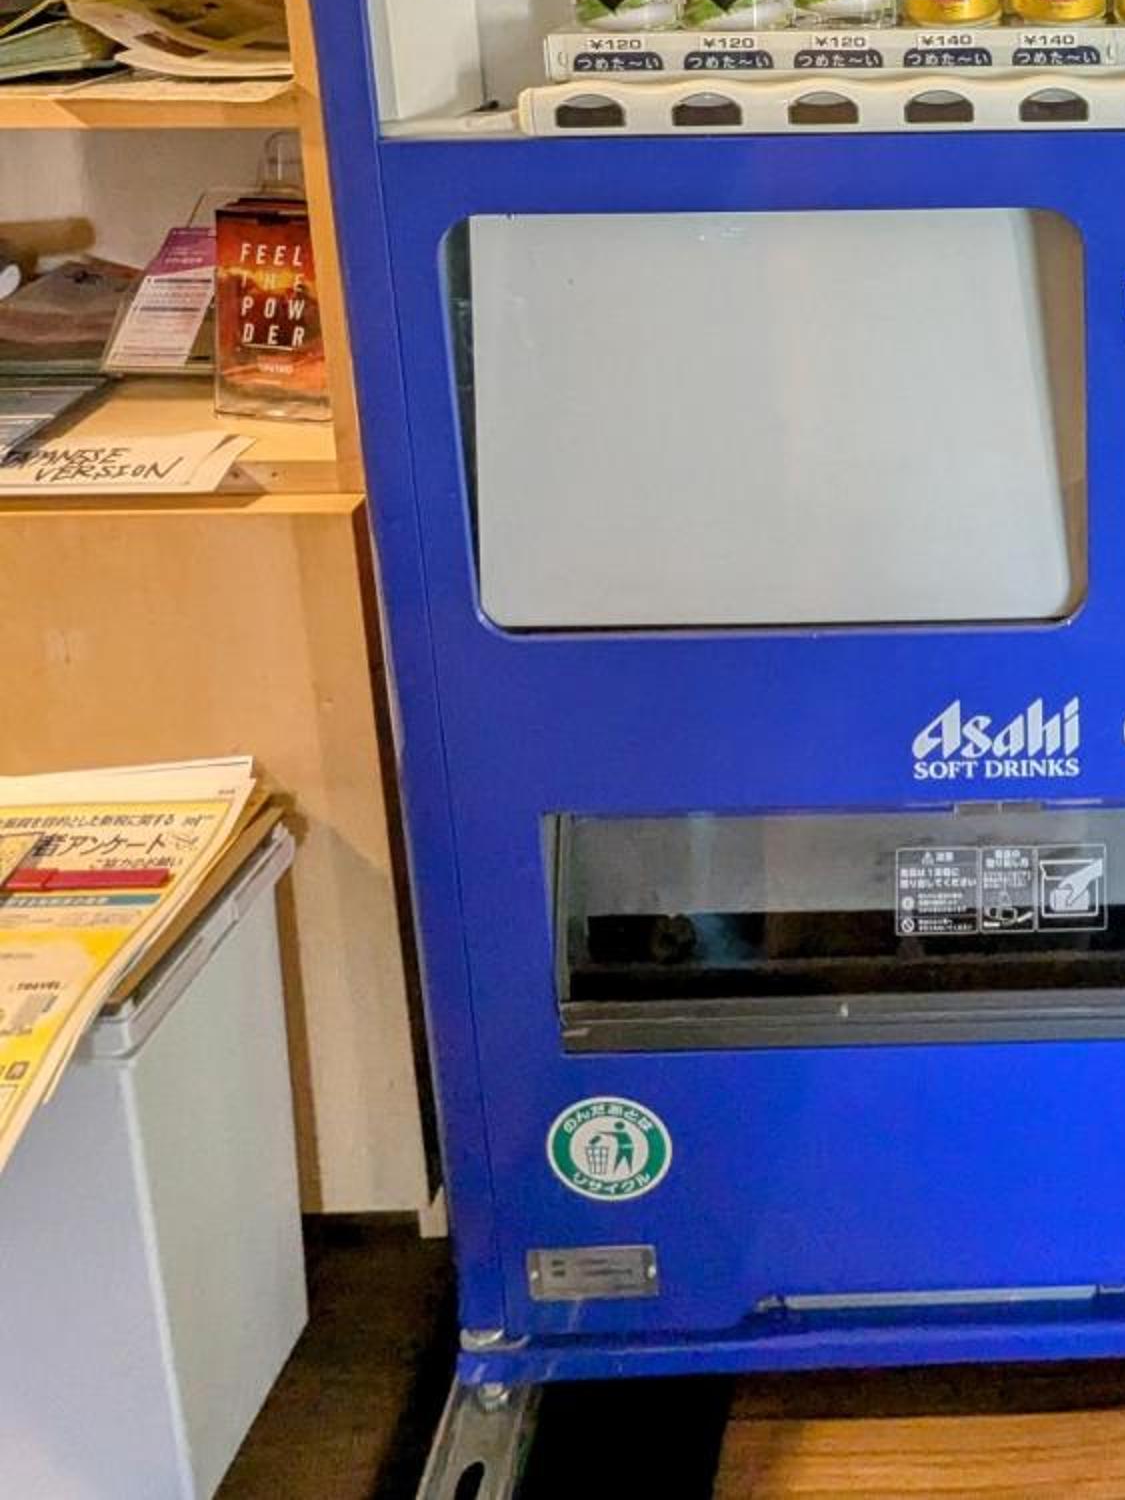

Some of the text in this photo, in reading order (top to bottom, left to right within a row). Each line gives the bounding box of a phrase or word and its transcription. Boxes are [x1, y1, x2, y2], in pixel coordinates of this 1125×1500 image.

[589, 38, 642, 50] ¥120
[703, 37, 755, 50] ¥120
[815, 36, 866, 48] ¥120
[921, 34, 972, 46] ¥140
[1024, 34, 1075, 46] ¥140
[240, 242, 304, 267] FEEL
[240, 296, 305, 321] POW
[241, 323, 306, 348] DER
[35, 455, 184, 482] VERSION
[911, 695, 1080, 760] Asahi
[912, 758, 1081, 781] SOFT DRINKS
[562, 1102, 655, 1135] のんだあとは
[572, 1171, 652, 1194] リサイクル
